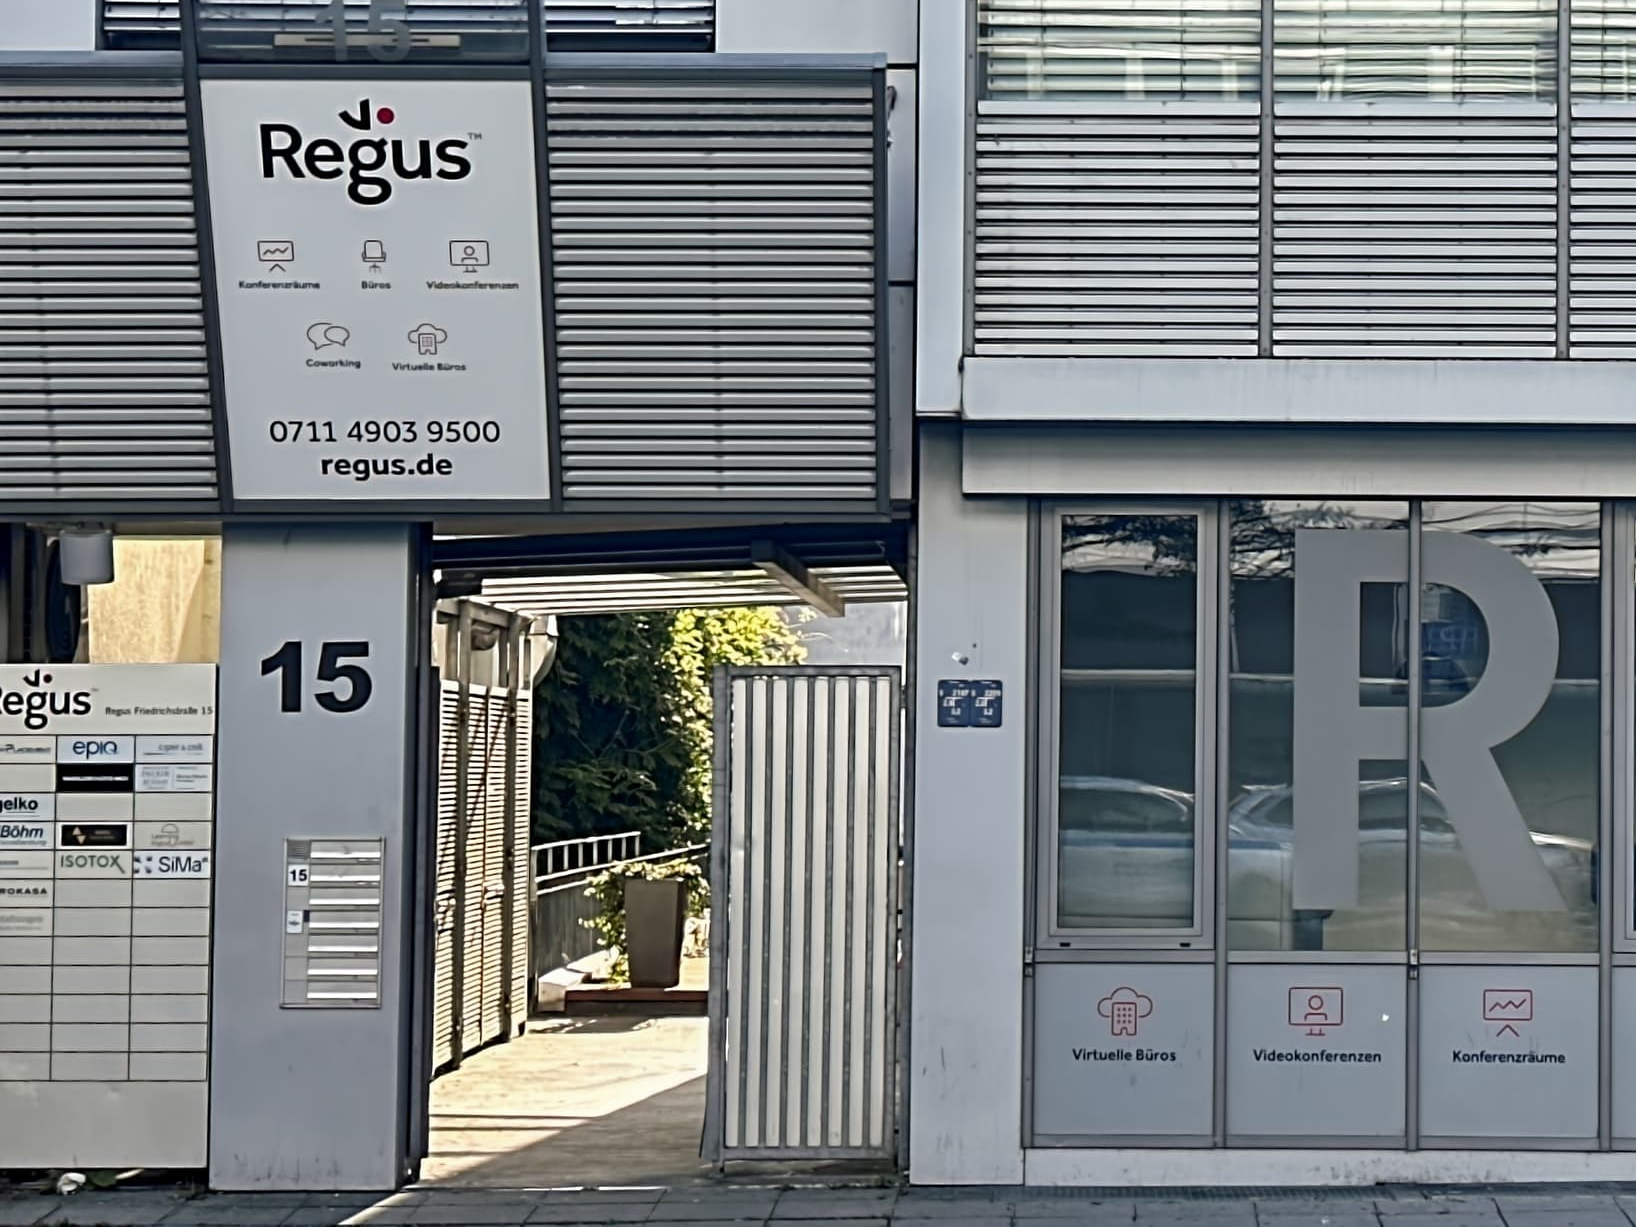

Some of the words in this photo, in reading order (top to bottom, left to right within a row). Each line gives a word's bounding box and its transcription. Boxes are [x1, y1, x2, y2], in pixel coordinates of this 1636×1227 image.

[361, 280, 392, 290] Büros
[305, 358, 362, 370] Coworking
[391, 361, 435, 372] Virtuelle
[437, 361, 468, 372] Büros
[269, 420, 338, 443] 0711
[346, 420, 418, 443] 4903
[426, 420, 501, 443] 9500
[320, 452, 454, 482] regus.de
[261, 641, 373, 713] 15
[0, 685, 91, 730] egus
[0, 797, 39, 813] elko
[60, 855, 126, 874] ISOTOX
[290, 868, 308, 883] 15
[1072, 1047, 1134, 1062] Virtuelle
[1136, 1047, 1177, 1062] Büros
[1253, 1048, 1382, 1063] Videokonferenzen
[1452, 1049, 1566, 1065] Konferenzräume
